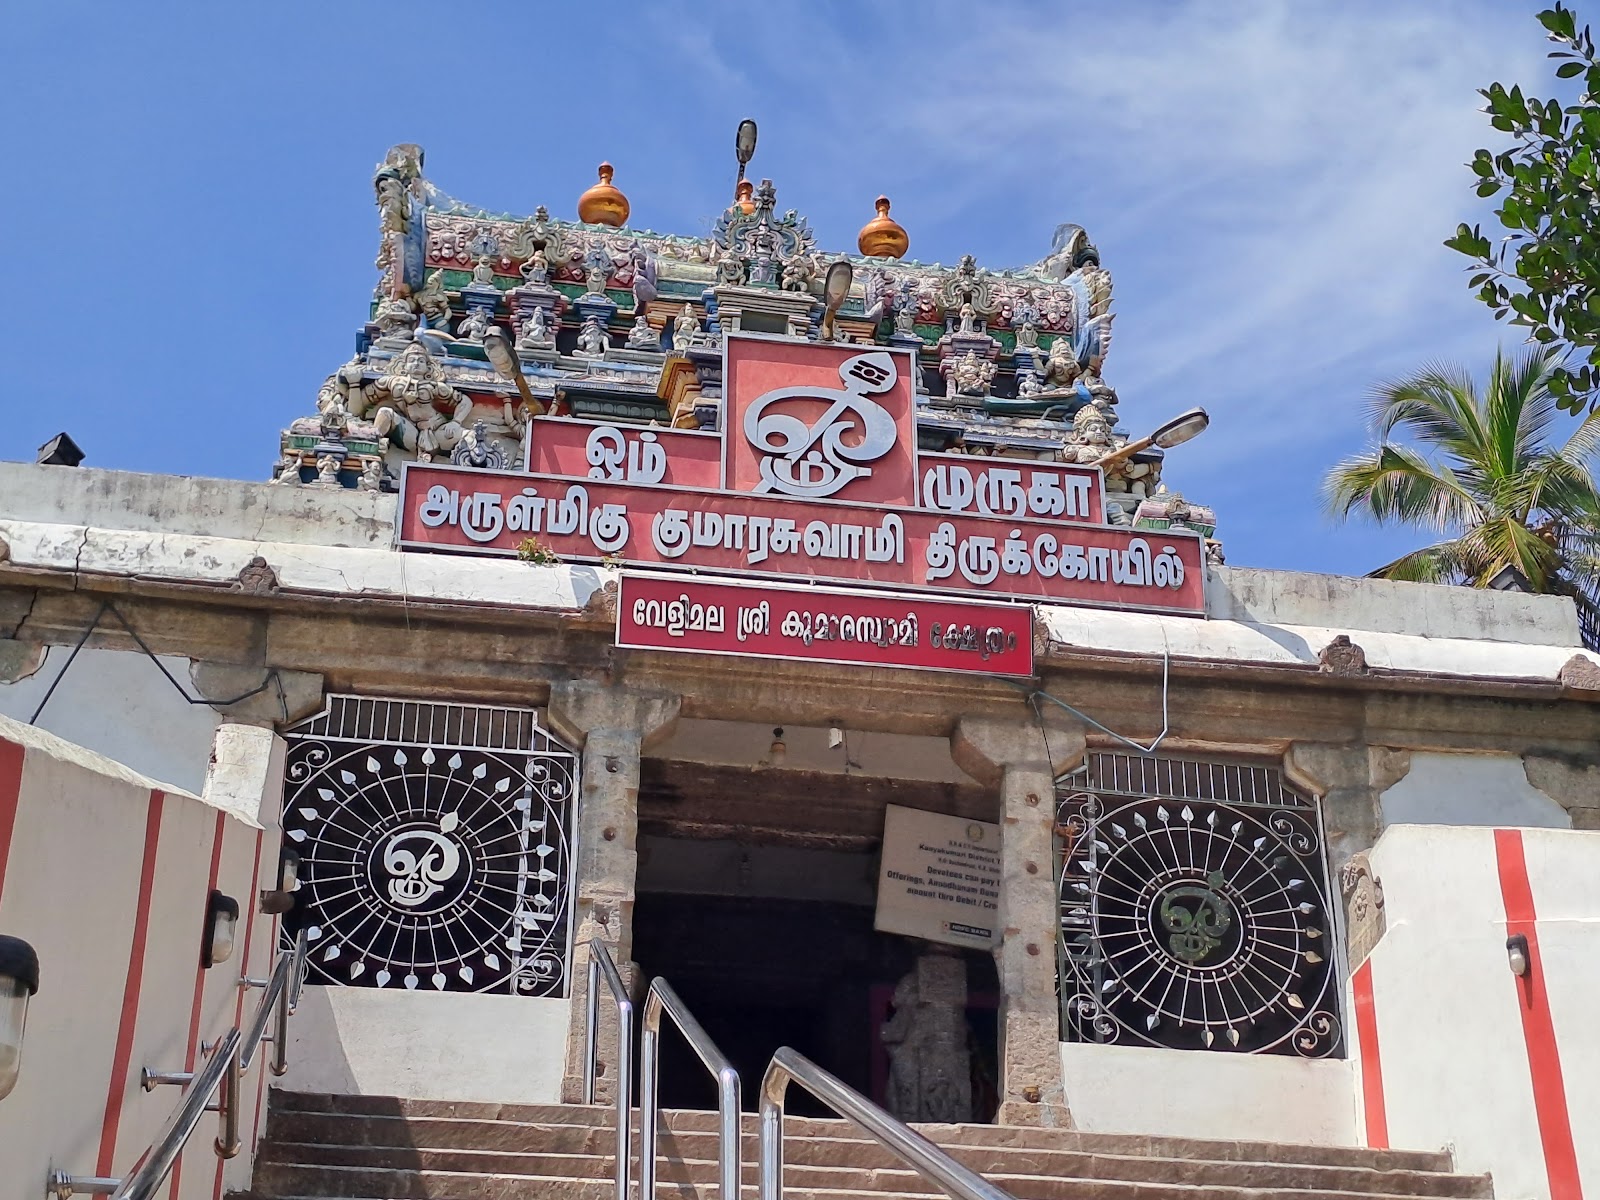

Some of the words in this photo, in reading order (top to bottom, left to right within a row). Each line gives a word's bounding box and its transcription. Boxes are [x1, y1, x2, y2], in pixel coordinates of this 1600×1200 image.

[585, 426, 667, 483] ஓம்
[923, 465, 1092, 518] முருகா
[419, 484, 630, 552] அருள்மிகு
[651, 508, 905, 564] குமாரசுவாமி
[926, 521, 1186, 591] திருக்கோயில்
[632, 593, 725, 637] വേളിമല
[736, 600, 770, 642] ശ്രീ
[780, 610, 919, 648] കുമാരസ്വാമി
[927, 865, 963, 880] Devotees
[965, 873, 979, 882] can
[981, 877, 995, 887] pay
